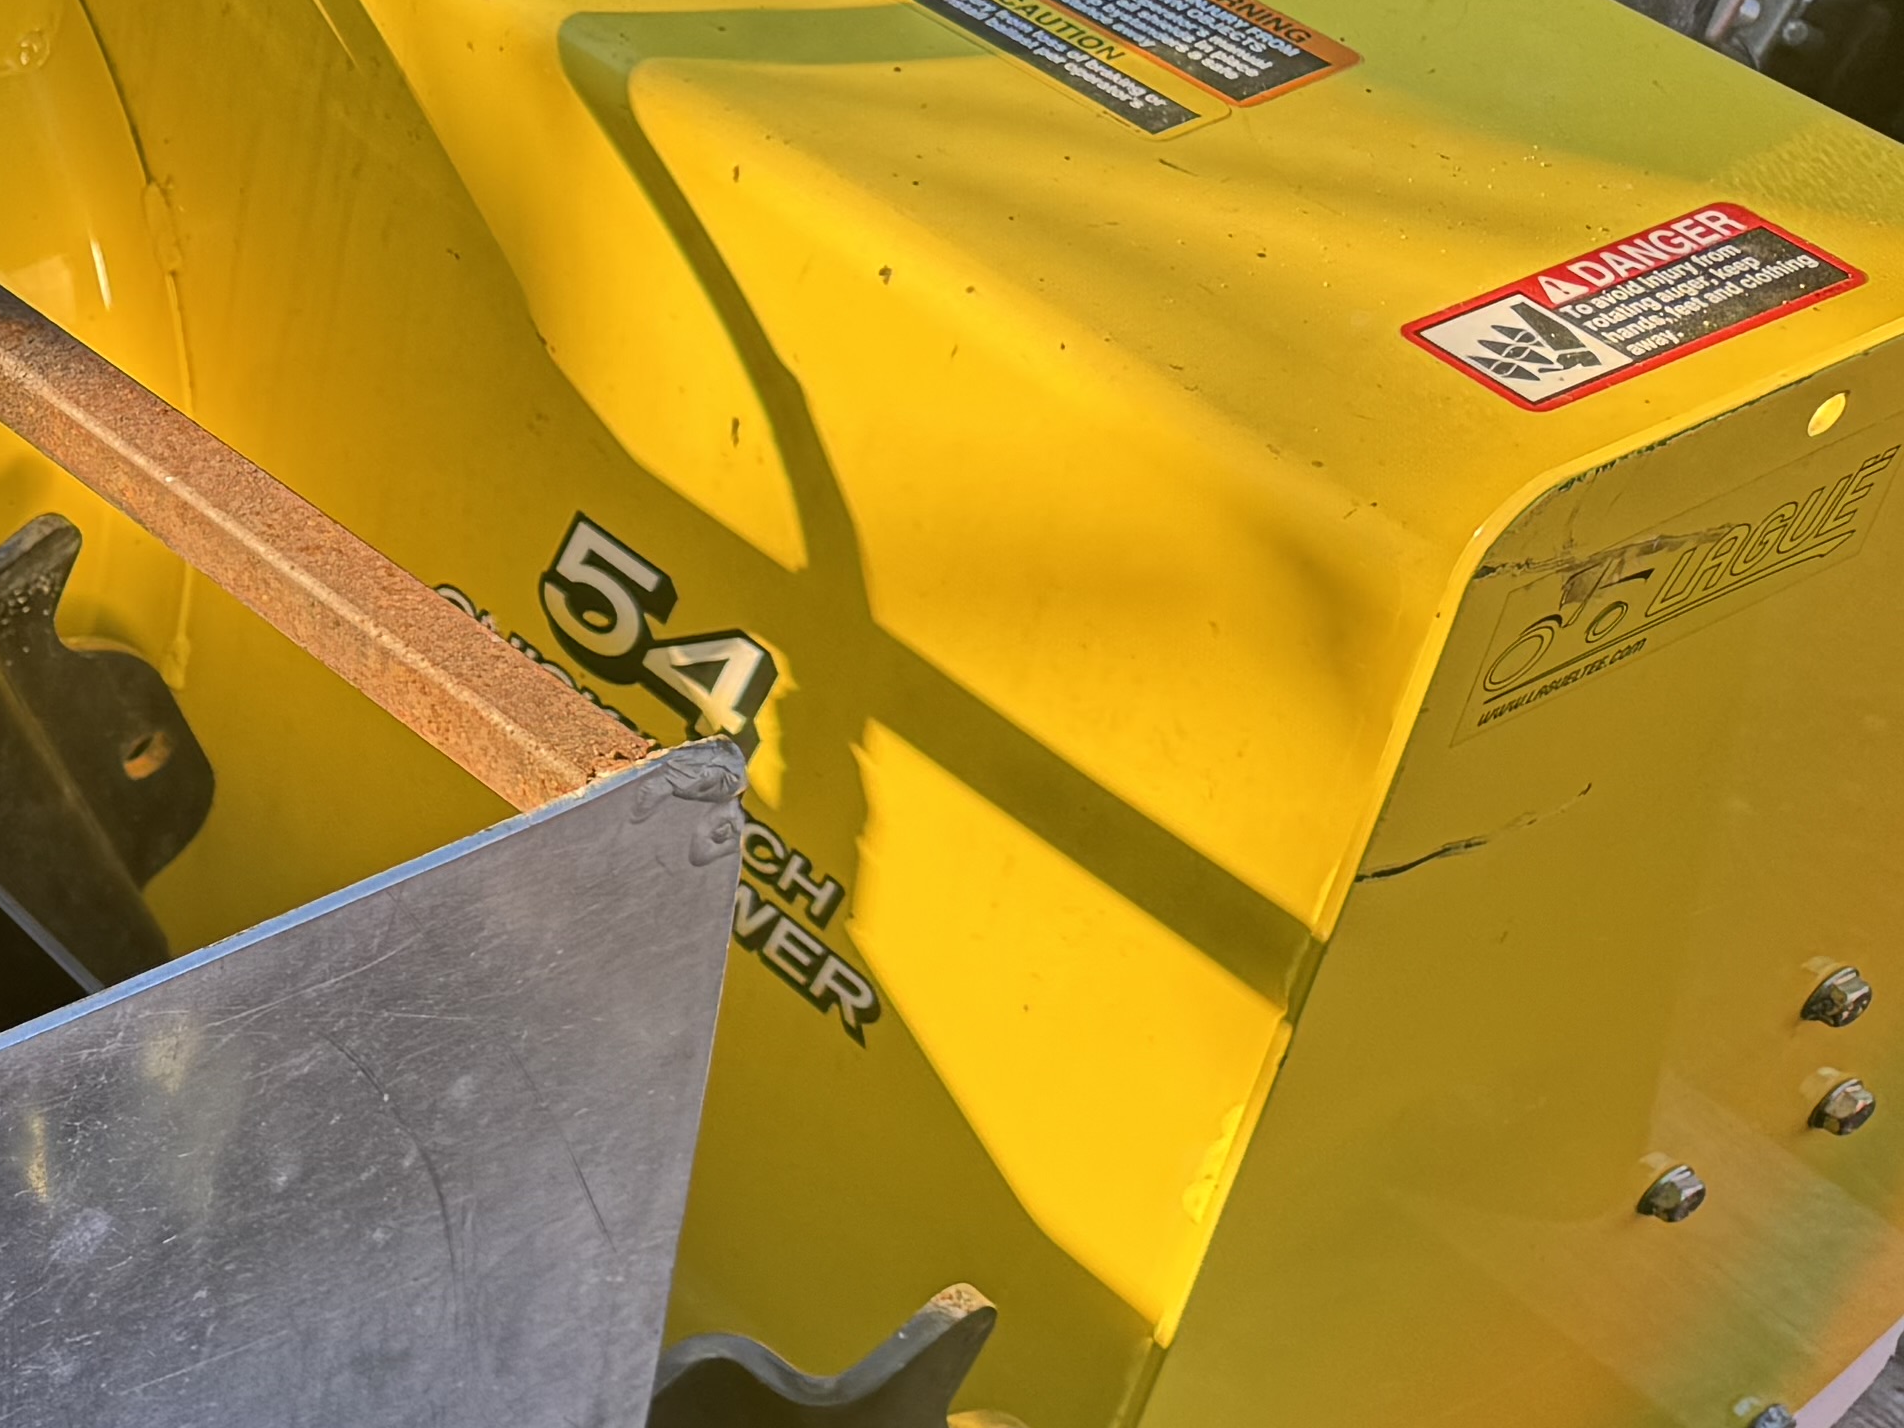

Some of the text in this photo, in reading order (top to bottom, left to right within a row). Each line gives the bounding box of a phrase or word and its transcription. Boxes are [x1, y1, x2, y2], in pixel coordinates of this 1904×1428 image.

[1186, 8, 1267, 53] OBJECTS
[1558, 303, 1594, 319] To
[1588, 280, 1646, 309] avoid
[1690, 244, 1742, 268] from
[1570, 210, 1747, 288] DANGER
[1663, 296, 1709, 319] feet
[1703, 280, 1744, 304] and
[1739, 254, 1820, 289] clothing
[1582, 256, 1761, 332] rotating auger, keep
[539, 510, 779, 759] 54
